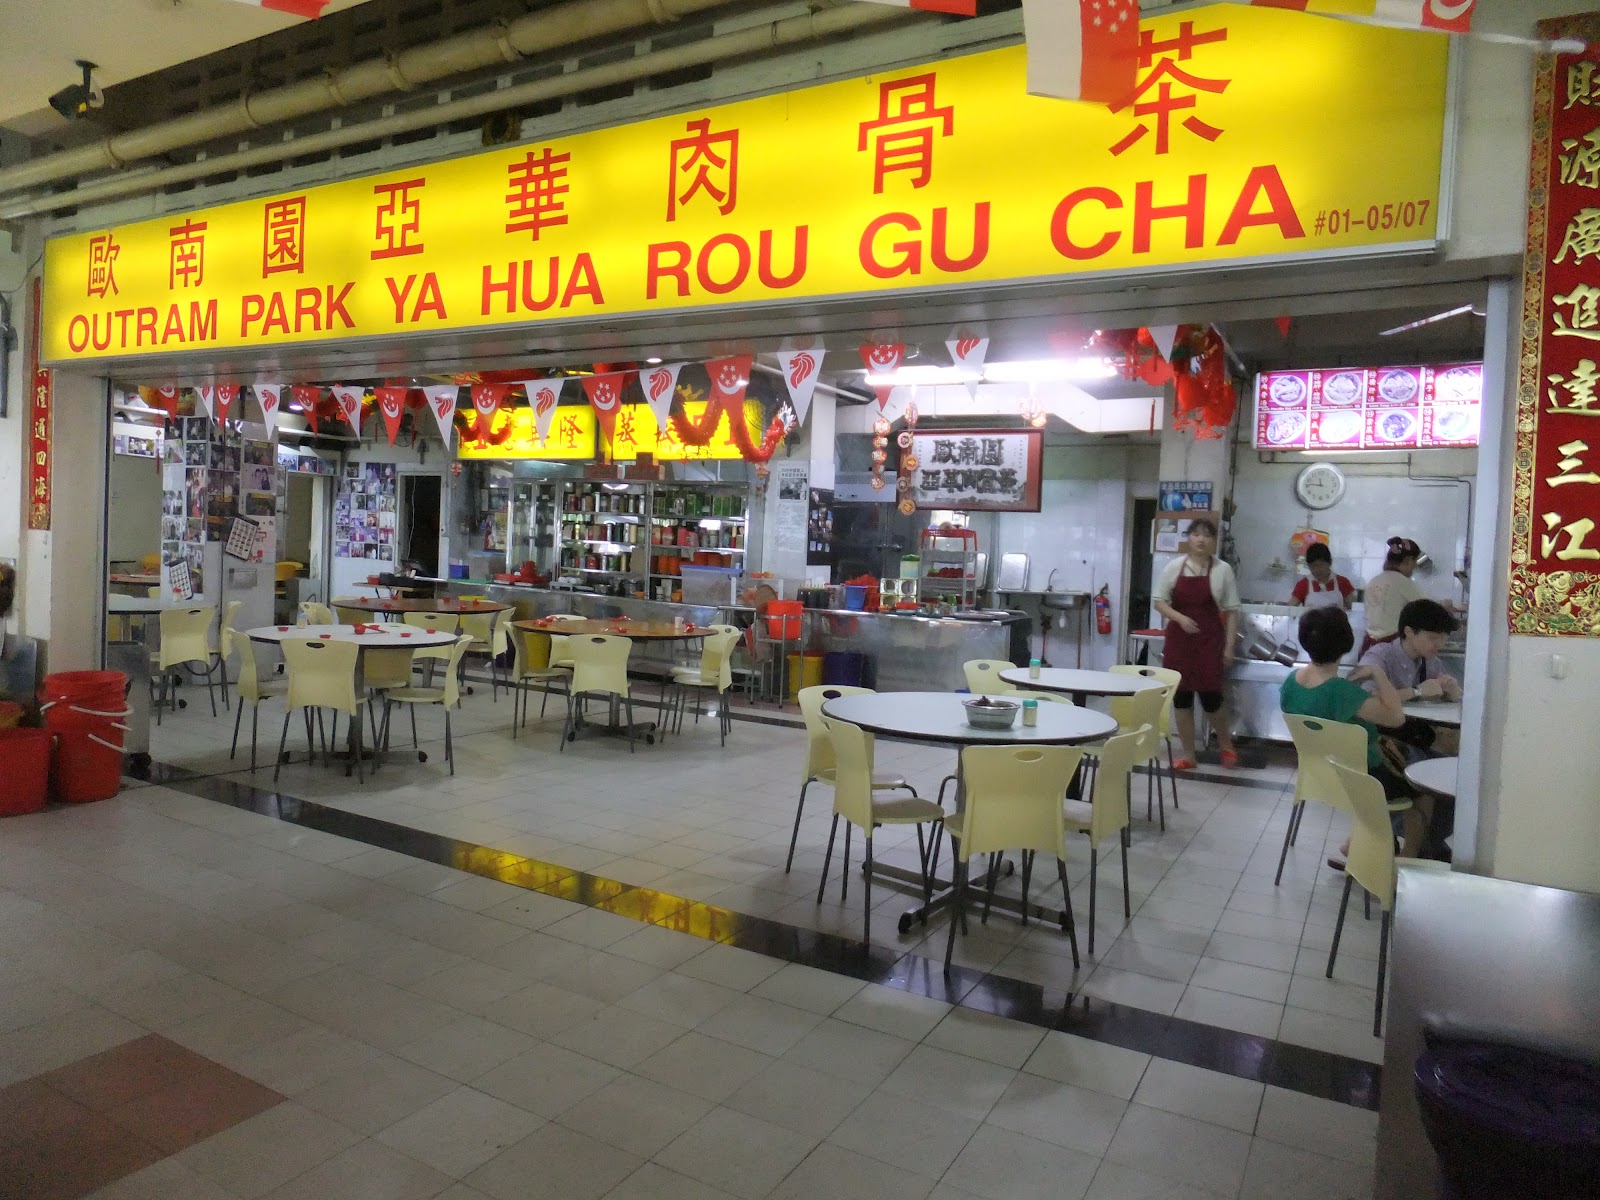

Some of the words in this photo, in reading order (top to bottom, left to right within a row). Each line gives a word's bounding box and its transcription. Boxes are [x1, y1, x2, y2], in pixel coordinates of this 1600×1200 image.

[68, 299, 217, 352] OUTRAM
[241, 282, 355, 337] PARK
[385, 272, 447, 323] YA
[482, 253, 604, 315] HUA
[646, 226, 808, 299] ROU
[859, 201, 990, 279] GU
[1051, 165, 1305, 260] CHA
[1314, 199, 1430, 236] #01-05/07
